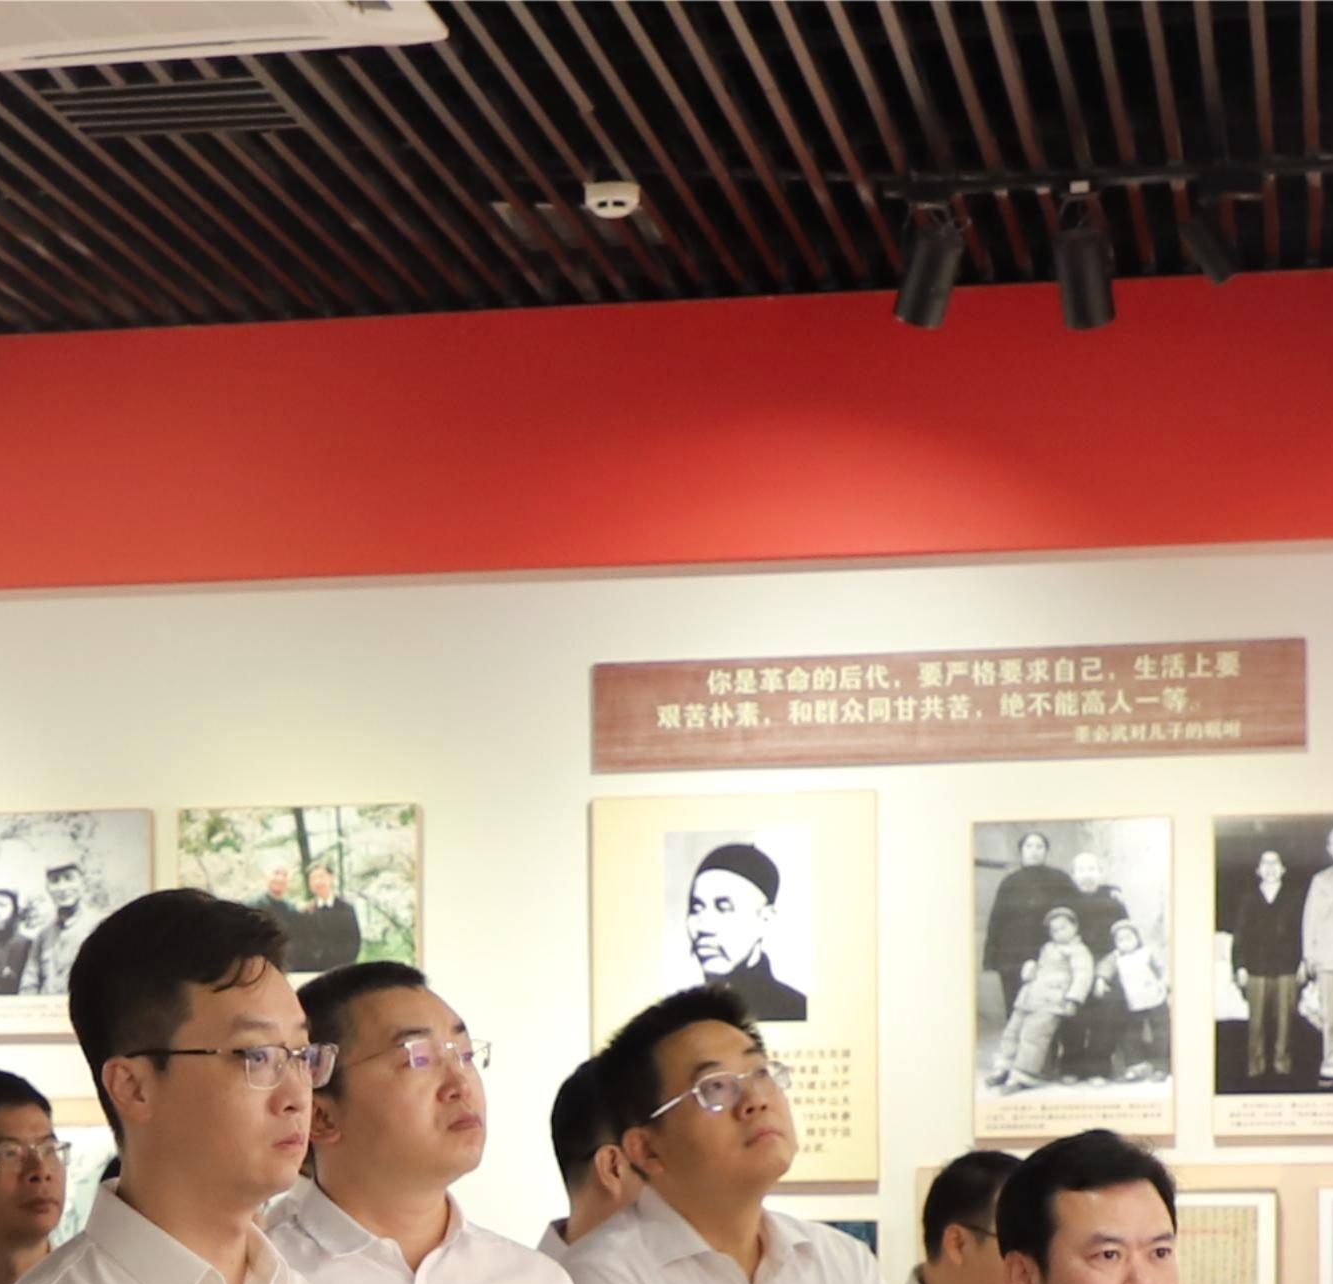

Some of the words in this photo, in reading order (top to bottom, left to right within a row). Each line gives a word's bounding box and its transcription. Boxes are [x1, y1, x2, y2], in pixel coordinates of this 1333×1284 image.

[707, 651, 1241, 696] 你是革命的后代，要严格要求自己，生活上要
